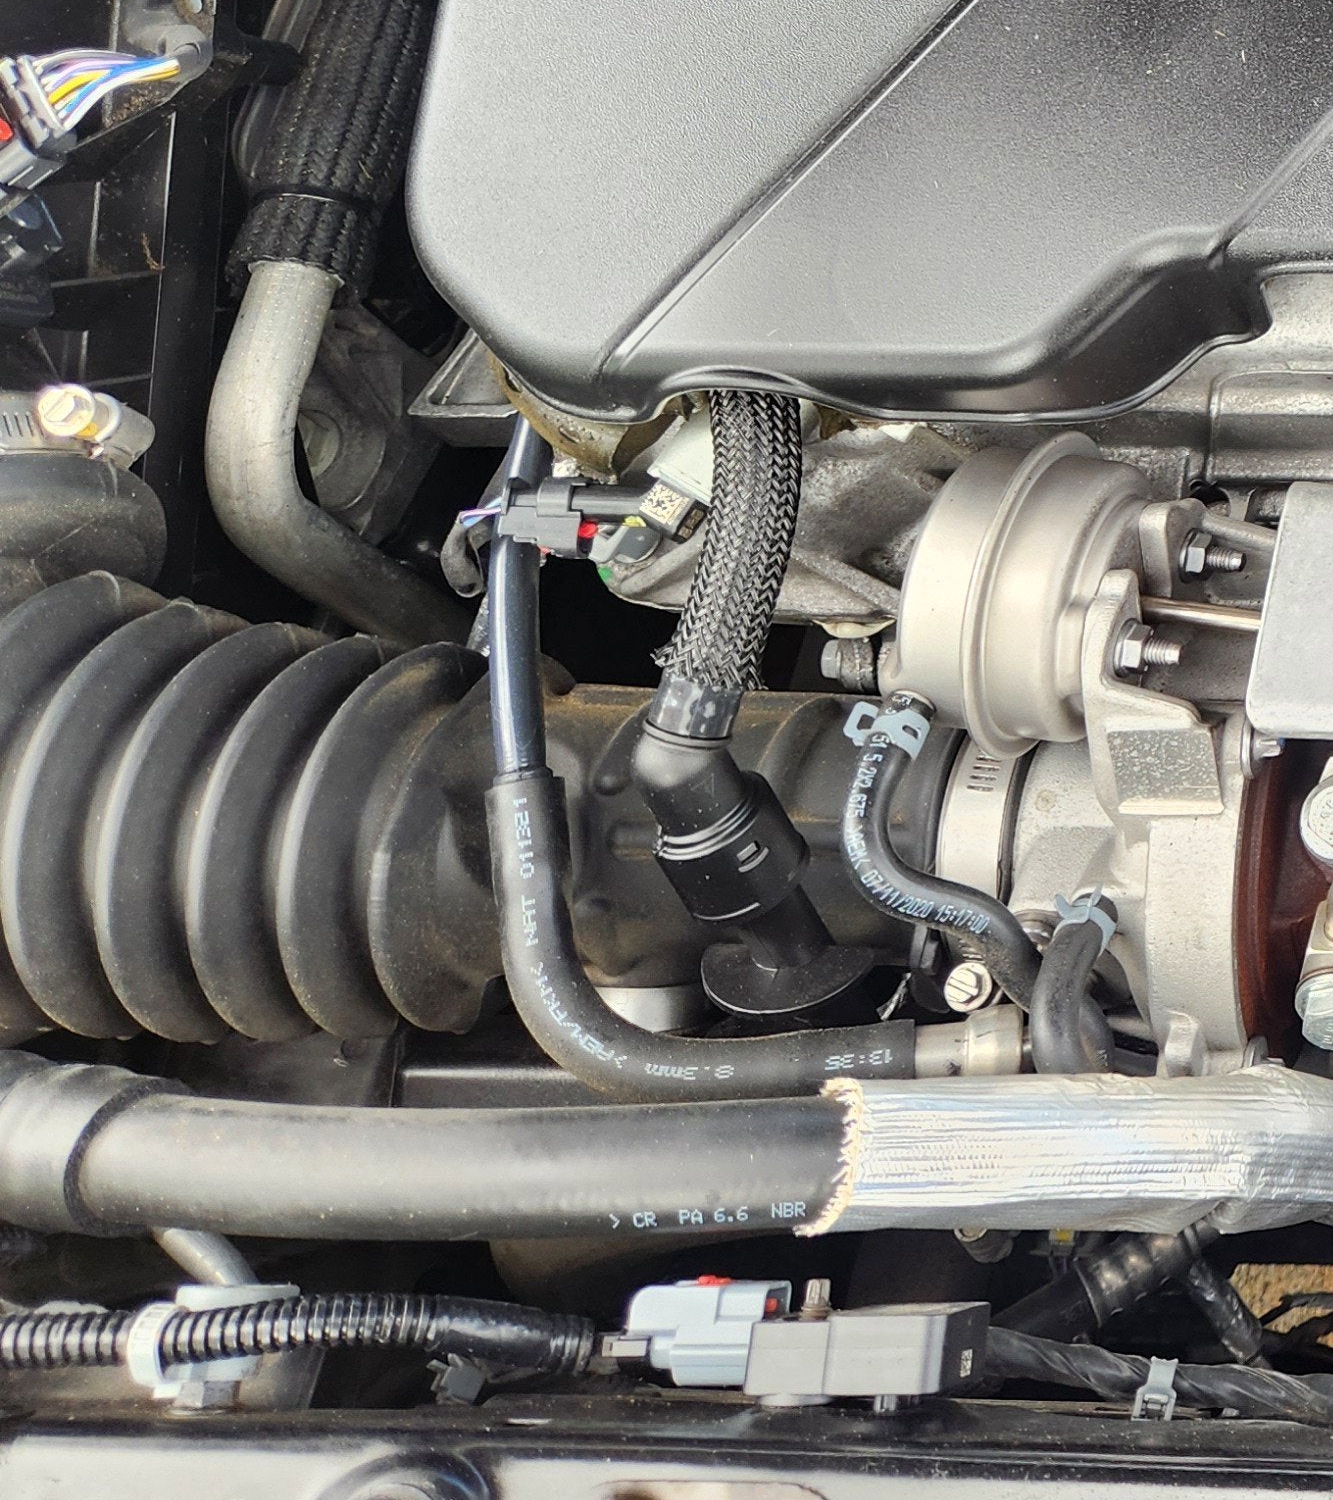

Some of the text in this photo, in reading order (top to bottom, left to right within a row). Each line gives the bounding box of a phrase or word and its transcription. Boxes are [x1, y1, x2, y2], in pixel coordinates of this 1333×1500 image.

[860, 869, 934, 920] 07/11/2020
[934, 903, 991, 936] 15:17:00
[824, 1048, 893, 1071] 13:35
[632, 1212, 659, 1230] CR
[678, 1208, 705, 1226] PA
[713, 1205, 750, 1224] 6.6
[770, 1201, 807, 1220] NBR
